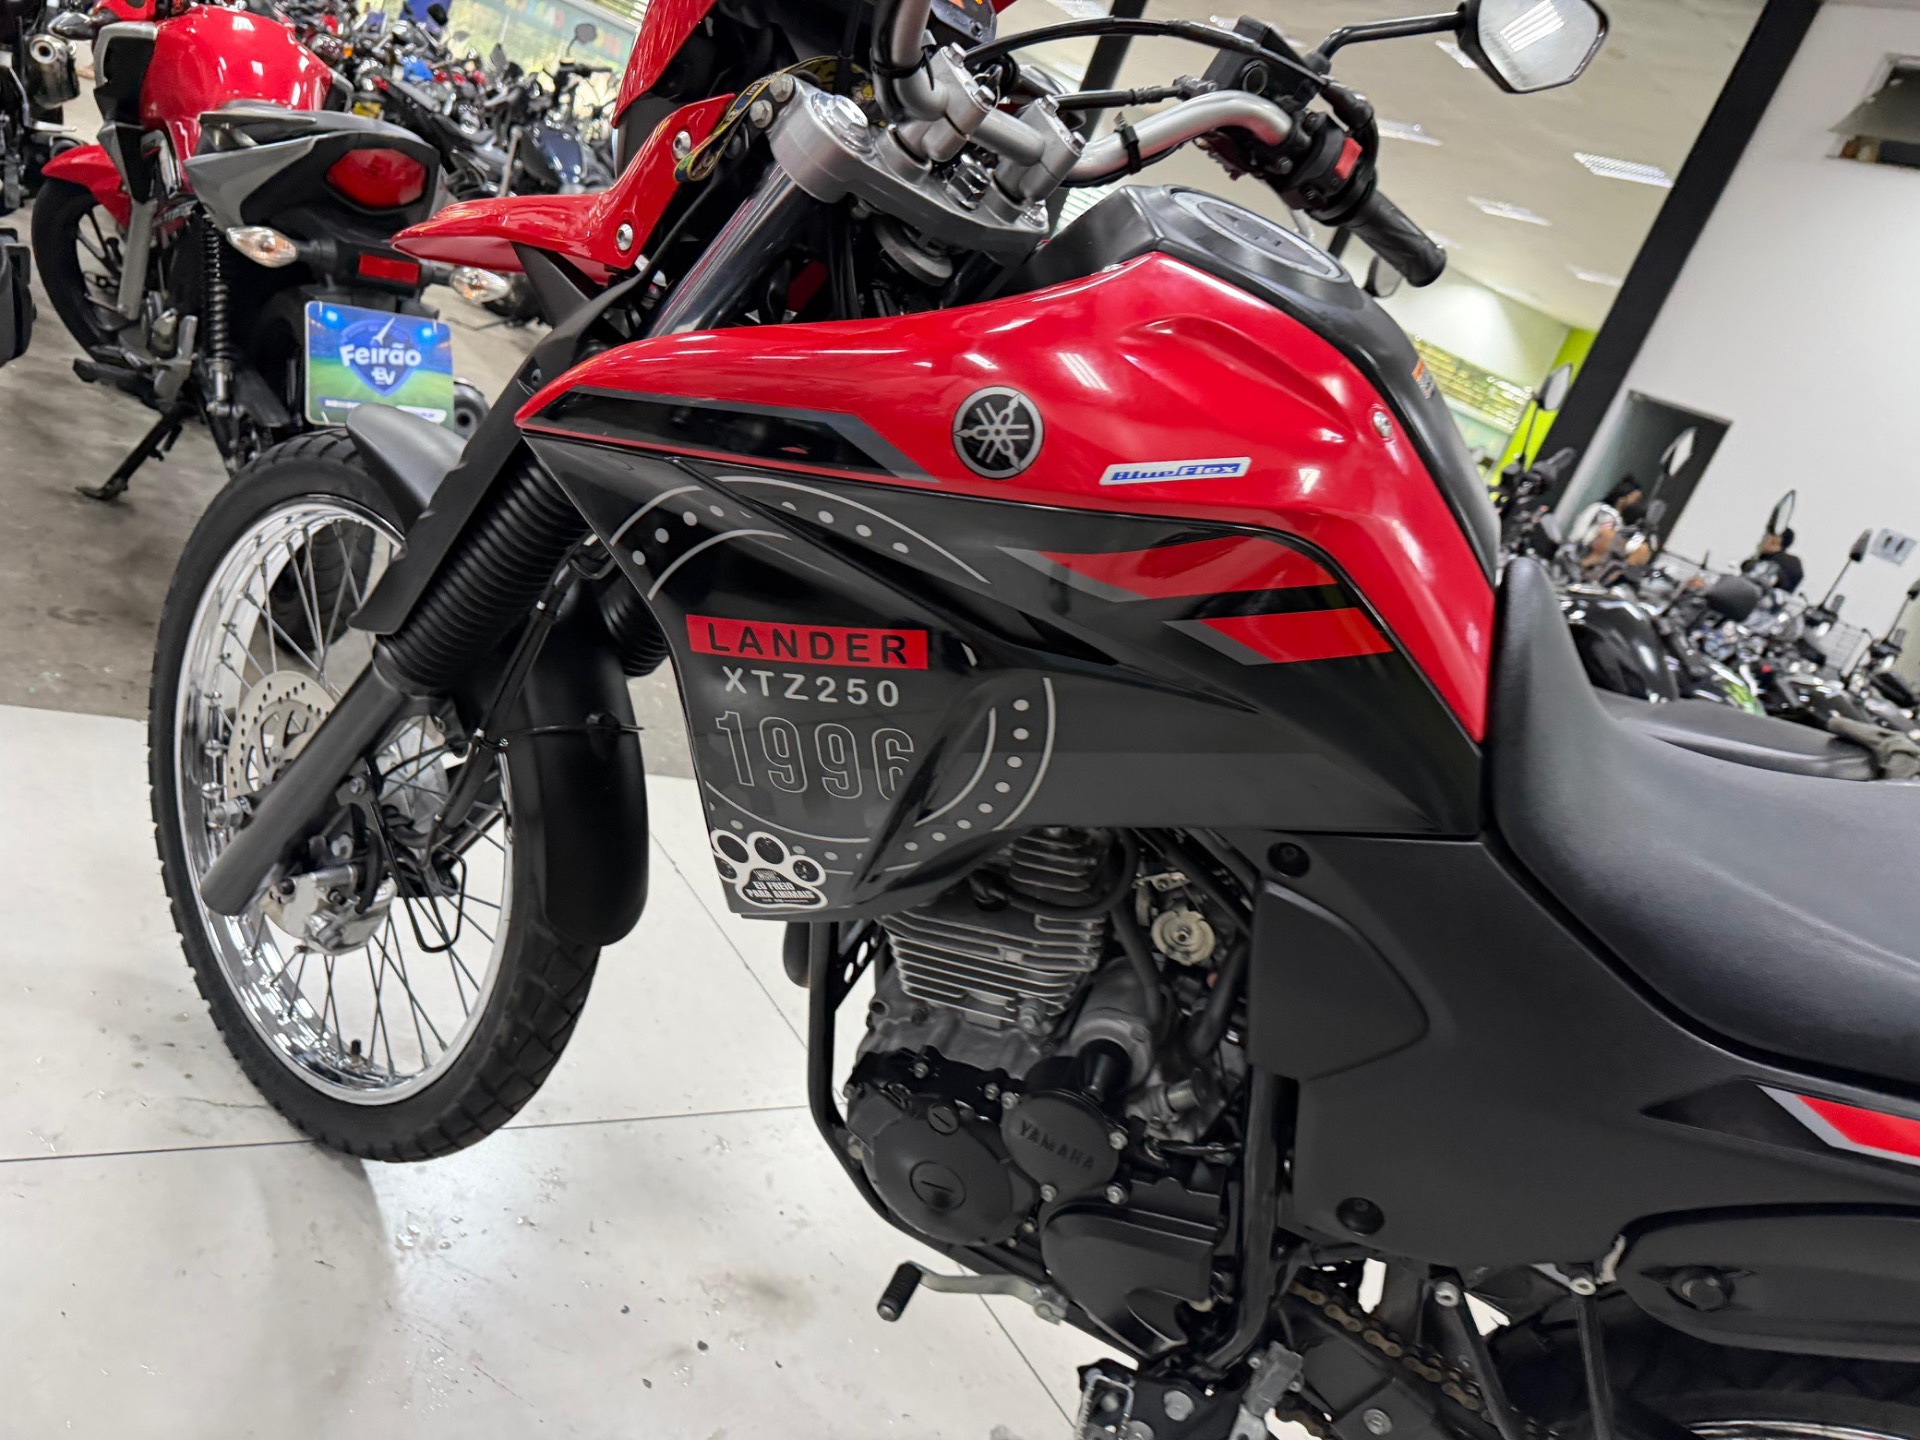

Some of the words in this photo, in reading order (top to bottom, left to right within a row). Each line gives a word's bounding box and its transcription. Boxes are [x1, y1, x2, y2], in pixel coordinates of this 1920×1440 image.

[340, 343, 422, 367] Feirão
[1111, 463, 1241, 481] BlueFlex
[707, 622, 908, 665] LANDER
[722, 665, 899, 707] XTZ250
[715, 710, 915, 801] 1996
[745, 888, 774, 898] PARA
[773, 889, 816, 899] ANIMAIS
[752, 881, 767, 890] EU
[766, 881, 796, 891] FREIO
[1020, 1119, 1096, 1171] YAMAHA
